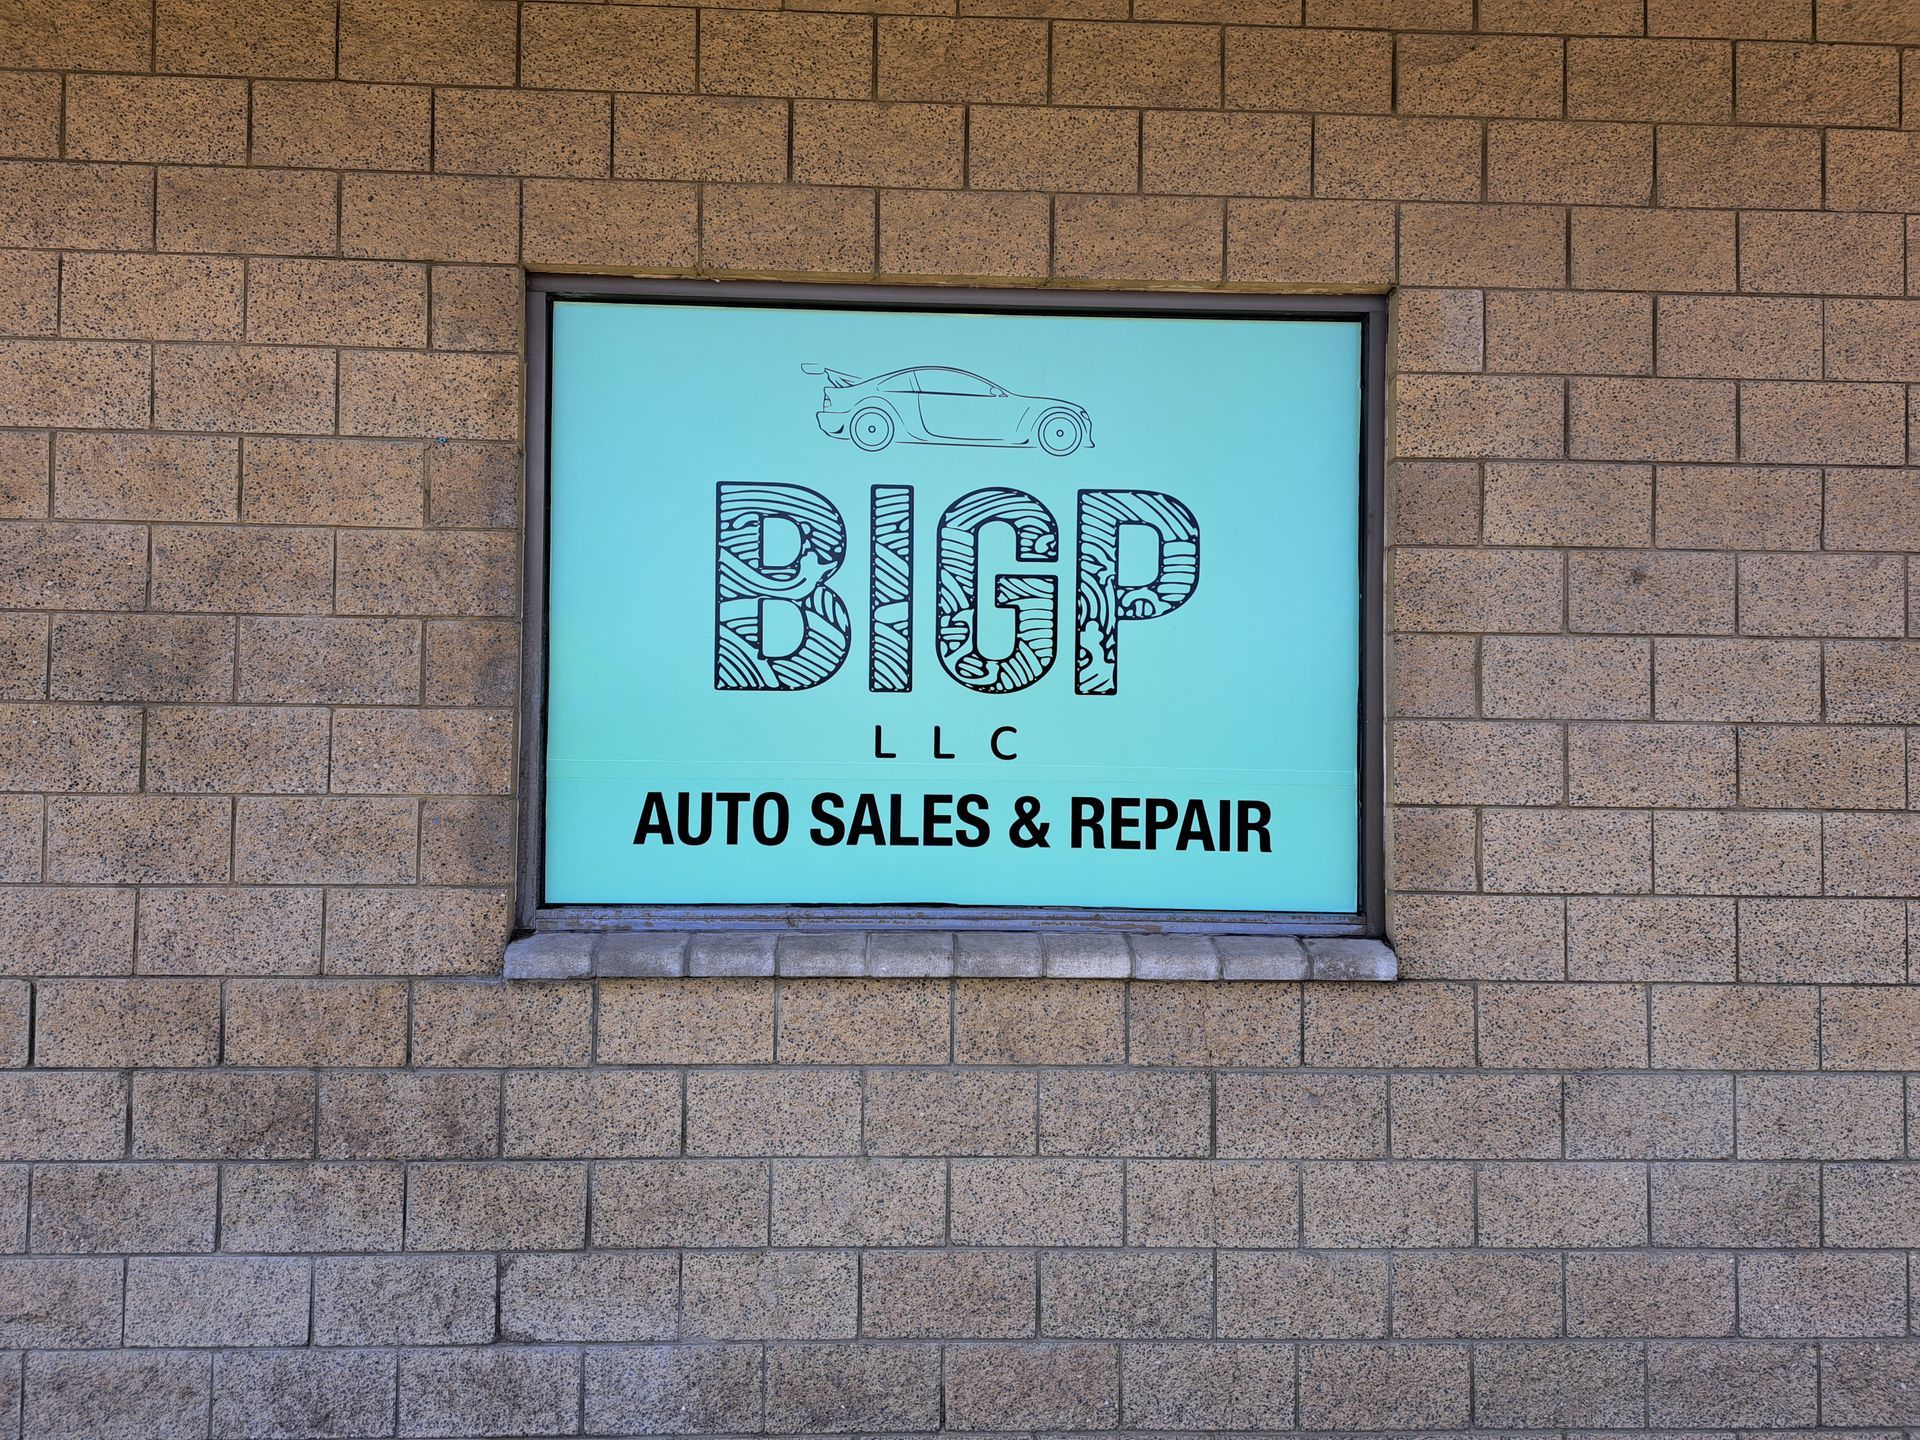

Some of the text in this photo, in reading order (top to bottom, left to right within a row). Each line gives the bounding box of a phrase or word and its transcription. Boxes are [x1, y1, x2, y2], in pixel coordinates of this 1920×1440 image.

[714, 481, 1201, 696] BIGP
[633, 791, 1273, 853] AUTO SALES & REPAIR
